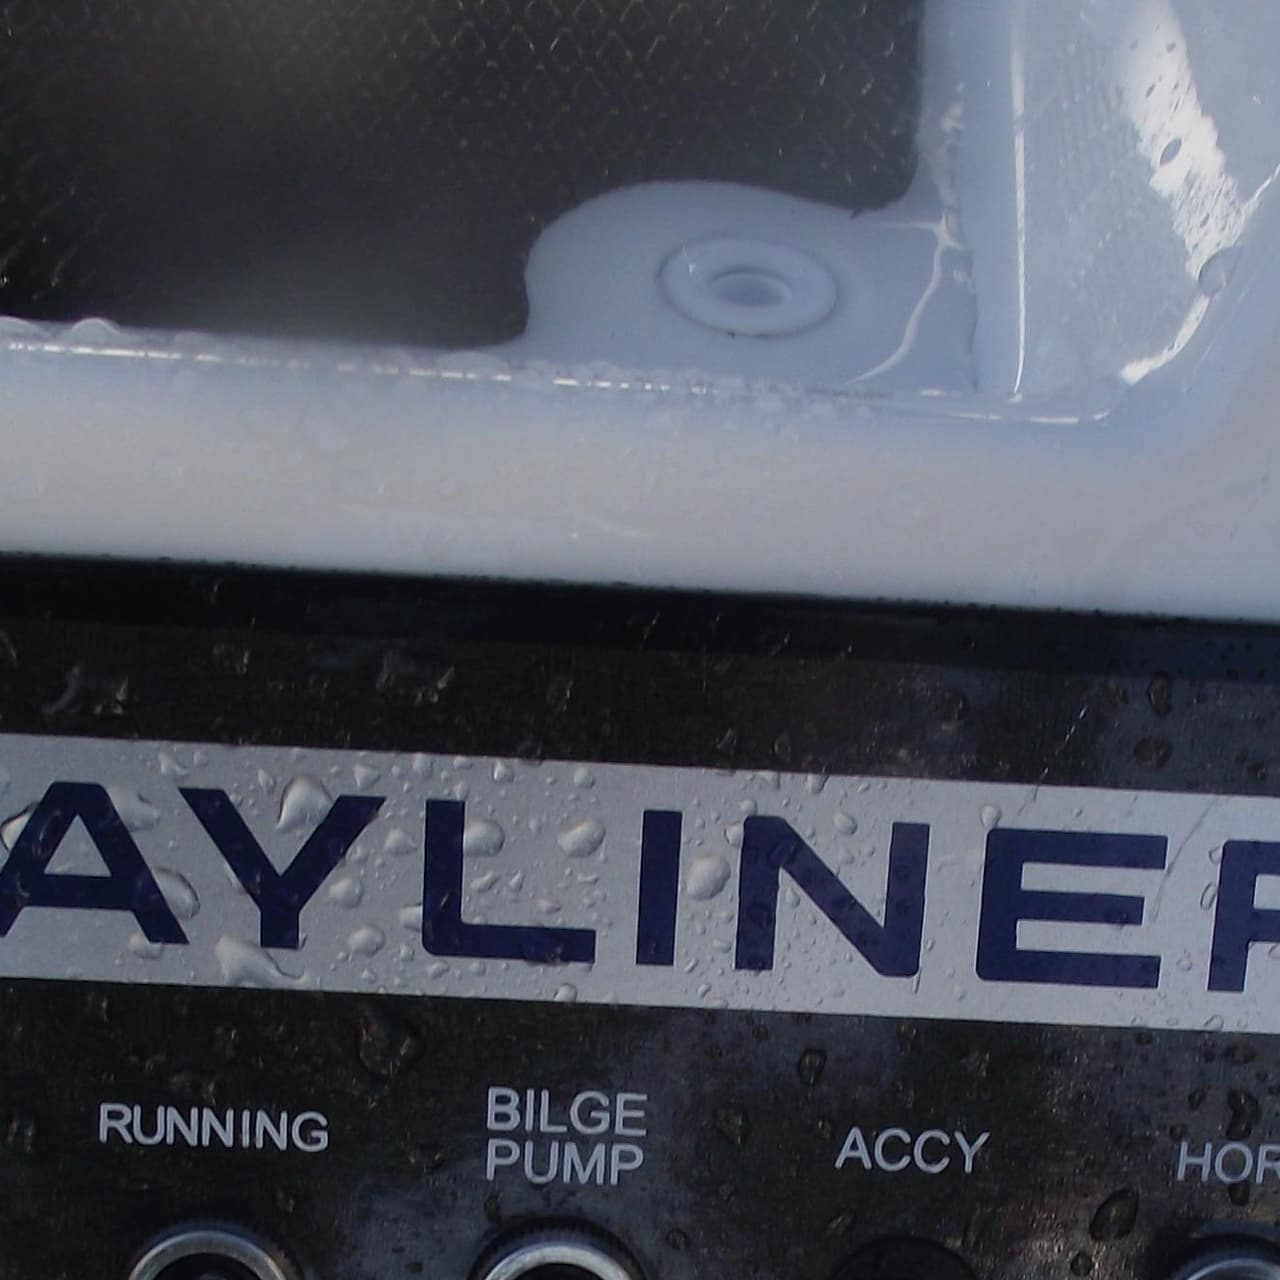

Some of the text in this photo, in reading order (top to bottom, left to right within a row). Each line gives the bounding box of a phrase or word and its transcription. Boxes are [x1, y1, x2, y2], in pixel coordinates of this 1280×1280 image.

[99, 1103, 329, 1152] RUNNING
[486, 1086, 648, 1137] BILGE
[486, 1138, 644, 1185] PUMP
[835, 1127, 990, 1174] ACCY
